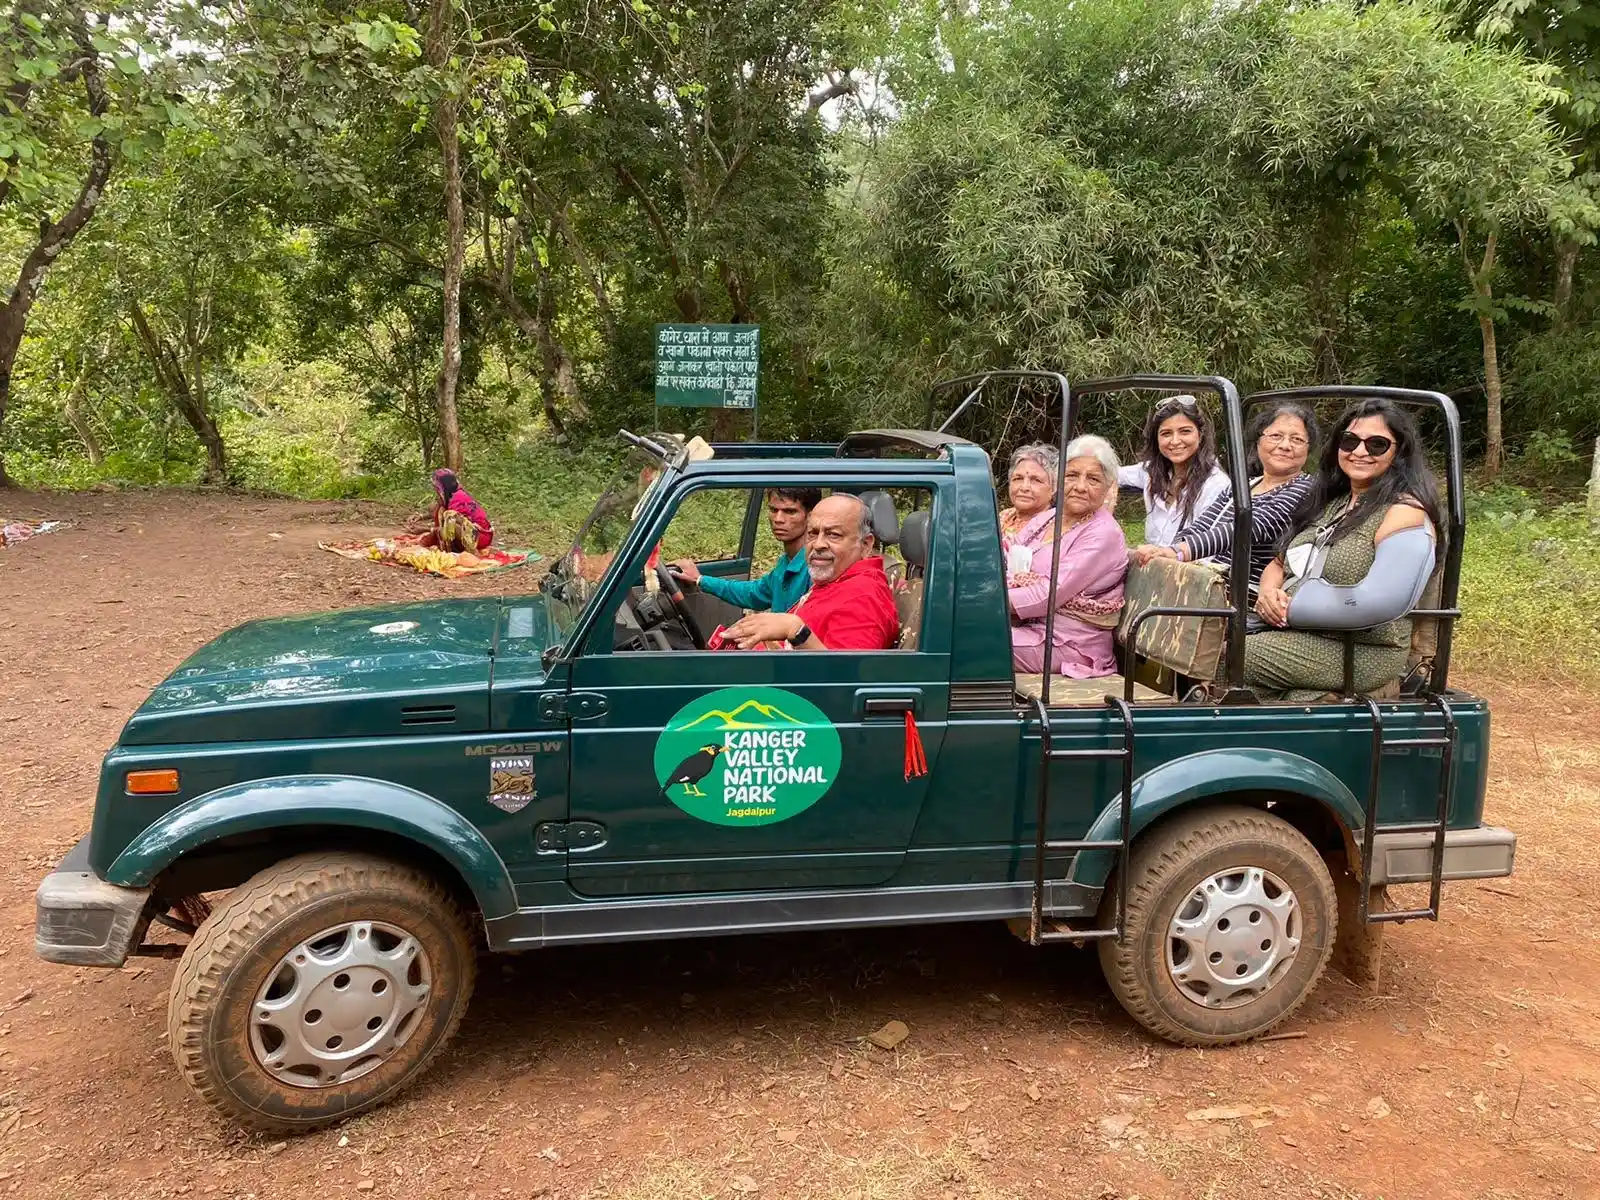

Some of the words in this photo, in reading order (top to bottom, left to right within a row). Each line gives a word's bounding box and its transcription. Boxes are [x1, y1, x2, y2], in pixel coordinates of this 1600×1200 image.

[712, 331, 730, 343] आग
[658, 361, 676, 372] आग
[724, 730, 806, 748] KANGER
[724, 748, 799, 767] VALLEY
[723, 766, 828, 785] NATIONAL
[723, 785, 777, 804] PARK
[726, 807, 777, 818] Jagdalpur
